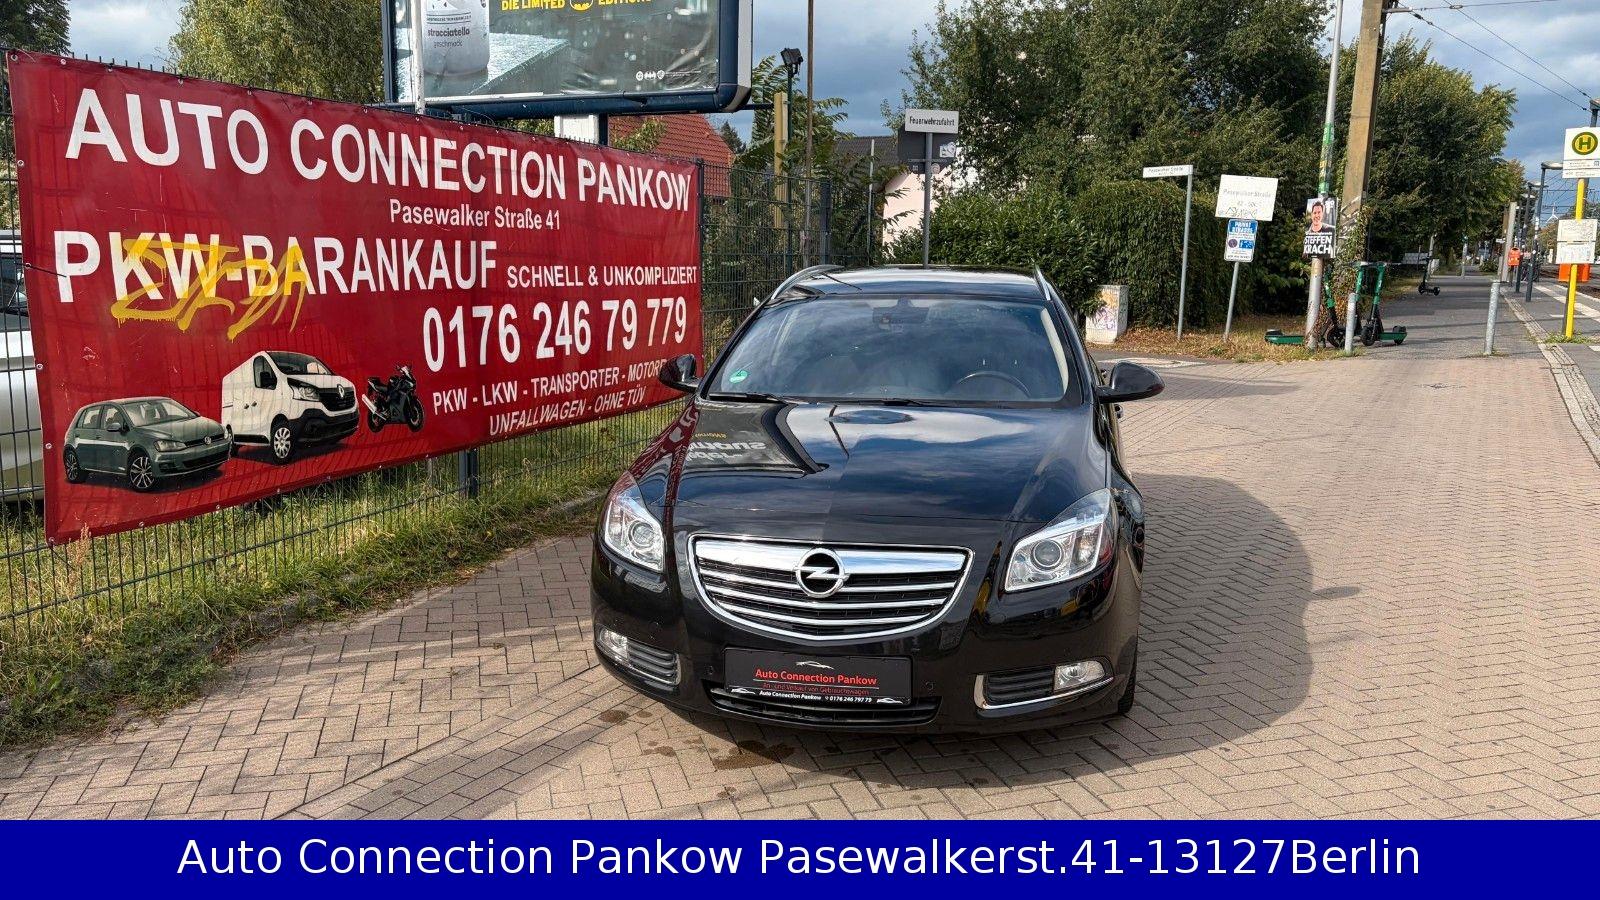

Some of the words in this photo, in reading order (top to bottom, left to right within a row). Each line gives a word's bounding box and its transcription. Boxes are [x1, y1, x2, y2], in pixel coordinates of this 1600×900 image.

[501, 0, 520, 10] DIE
[522, 0, 566, 9] LIMITED
[428, 27, 470, 37] stracciatella
[909, 115, 955, 126] Feuerwehrzufahrt
[65, 88, 269, 174] AUTO
[290, 117, 567, 200] CONNECTION
[578, 158, 691, 212] PANKOW
[1578, 137, 1592, 150] H
[389, 198, 490, 227] Pasewalker
[494, 205, 543, 230] Straße
[545, 210, 561, 230] 41
[1304, 236, 1333, 245] STEFFEN
[1303, 244, 1332, 255] KRACH
[54, 231, 498, 303] PKW-BARANKAUF
[507, 265, 584, 288] SCHNELL
[588, 266, 599, 286] &
[603, 266, 697, 287] UNKOMPLIZIERT
[423, 303, 521, 373] 0176
[533, 300, 592, 360] 246
[602, 298, 638, 352] 79
[647, 296, 687, 347] 779
[433, 387, 468, 416] PKW
[482, 380, 518, 407] LKW
[531, 366, 620, 399] TRANSPORTER
[489, 398, 587, 436] UNFALLWAGEN
[594, 390, 624, 413] OHNE
[627, 384, 647, 405] TÜV
[755, 669, 778, 679] Auto
[780, 671, 835, 683] Connection
[837, 675, 877, 685] Pankow
